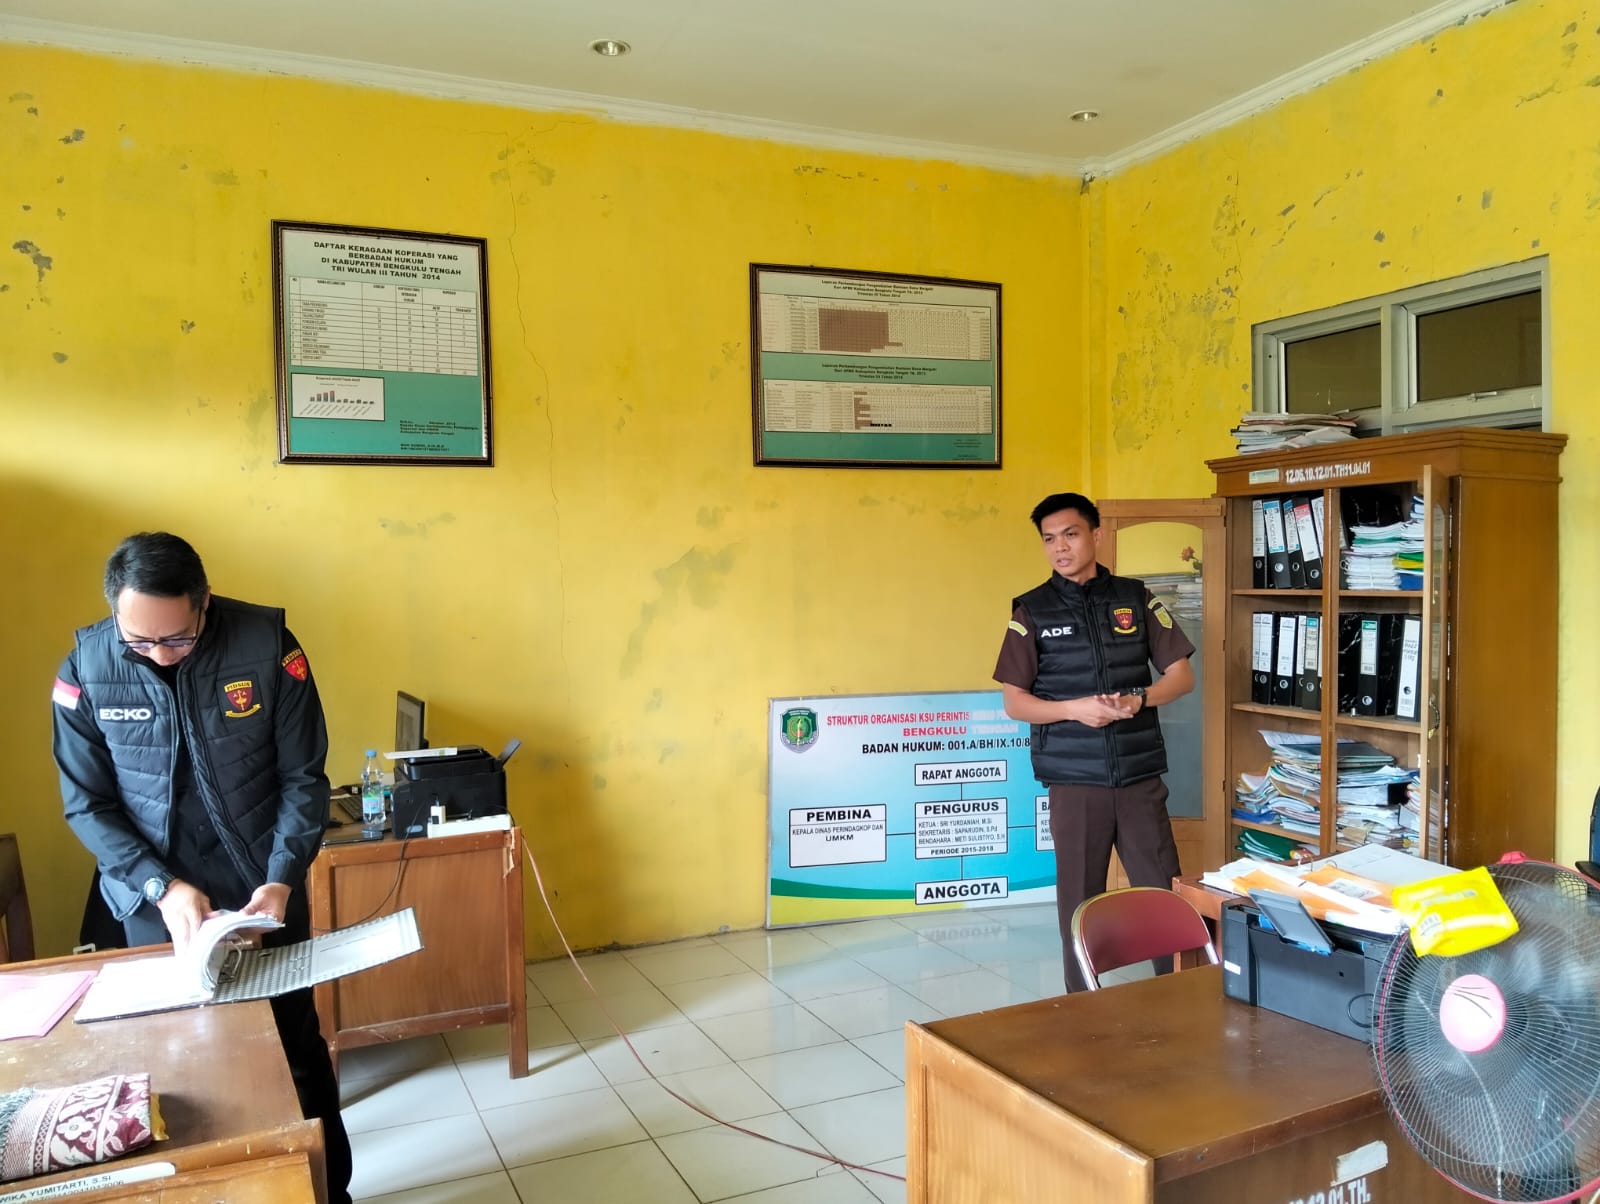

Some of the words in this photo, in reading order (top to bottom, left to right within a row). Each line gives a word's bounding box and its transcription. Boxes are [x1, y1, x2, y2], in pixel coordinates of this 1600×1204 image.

[314, 241, 346, 251] DAFTAR
[348, 245, 393, 255] KERAGAAN
[395, 249, 435, 259] KOPERASI
[438, 253, 459, 261] YANG
[348, 252, 392, 262] BERBADAN
[394, 256, 424, 265] HUKUM
[332, 258, 381, 268] KABUPATEN
[383, 263, 427, 273] BENGKULU
[430, 267, 461, 276] TENGAH
[347, 267, 377, 275] WULAN
[390, 270, 417, 279] TAHUN
[1041, 626, 1072, 638] ADE
[99, 708, 151, 720] ECKO
[826, 715, 869, 726] STRUKTUR
[871, 713, 916, 724] ORGANISASI
[919, 712, 935, 723] KSU
[903, 726, 967, 737] BENGKULU
[862, 742, 899, 754] BADAN
[902, 740, 945, 752] HUKUM:
[922, 769, 952, 780] RAPAT
[955, 767, 1001, 779] ANGGOTA
[924, 801, 1000, 815] PENGURUS
[806, 809, 872, 822] PEMBINA
[792, 827, 814, 835] KEPALA
[815, 826, 831, 834] DINAS
[918, 821, 936, 829] KETUA
[825, 834, 854, 842] UMKM
[918, 829, 951, 837] SEKRETARIS
[918, 837, 951, 845] BENDAHARA
[930, 848, 960, 856] PERIODE
[924, 882, 1000, 899] ANGGOTA
